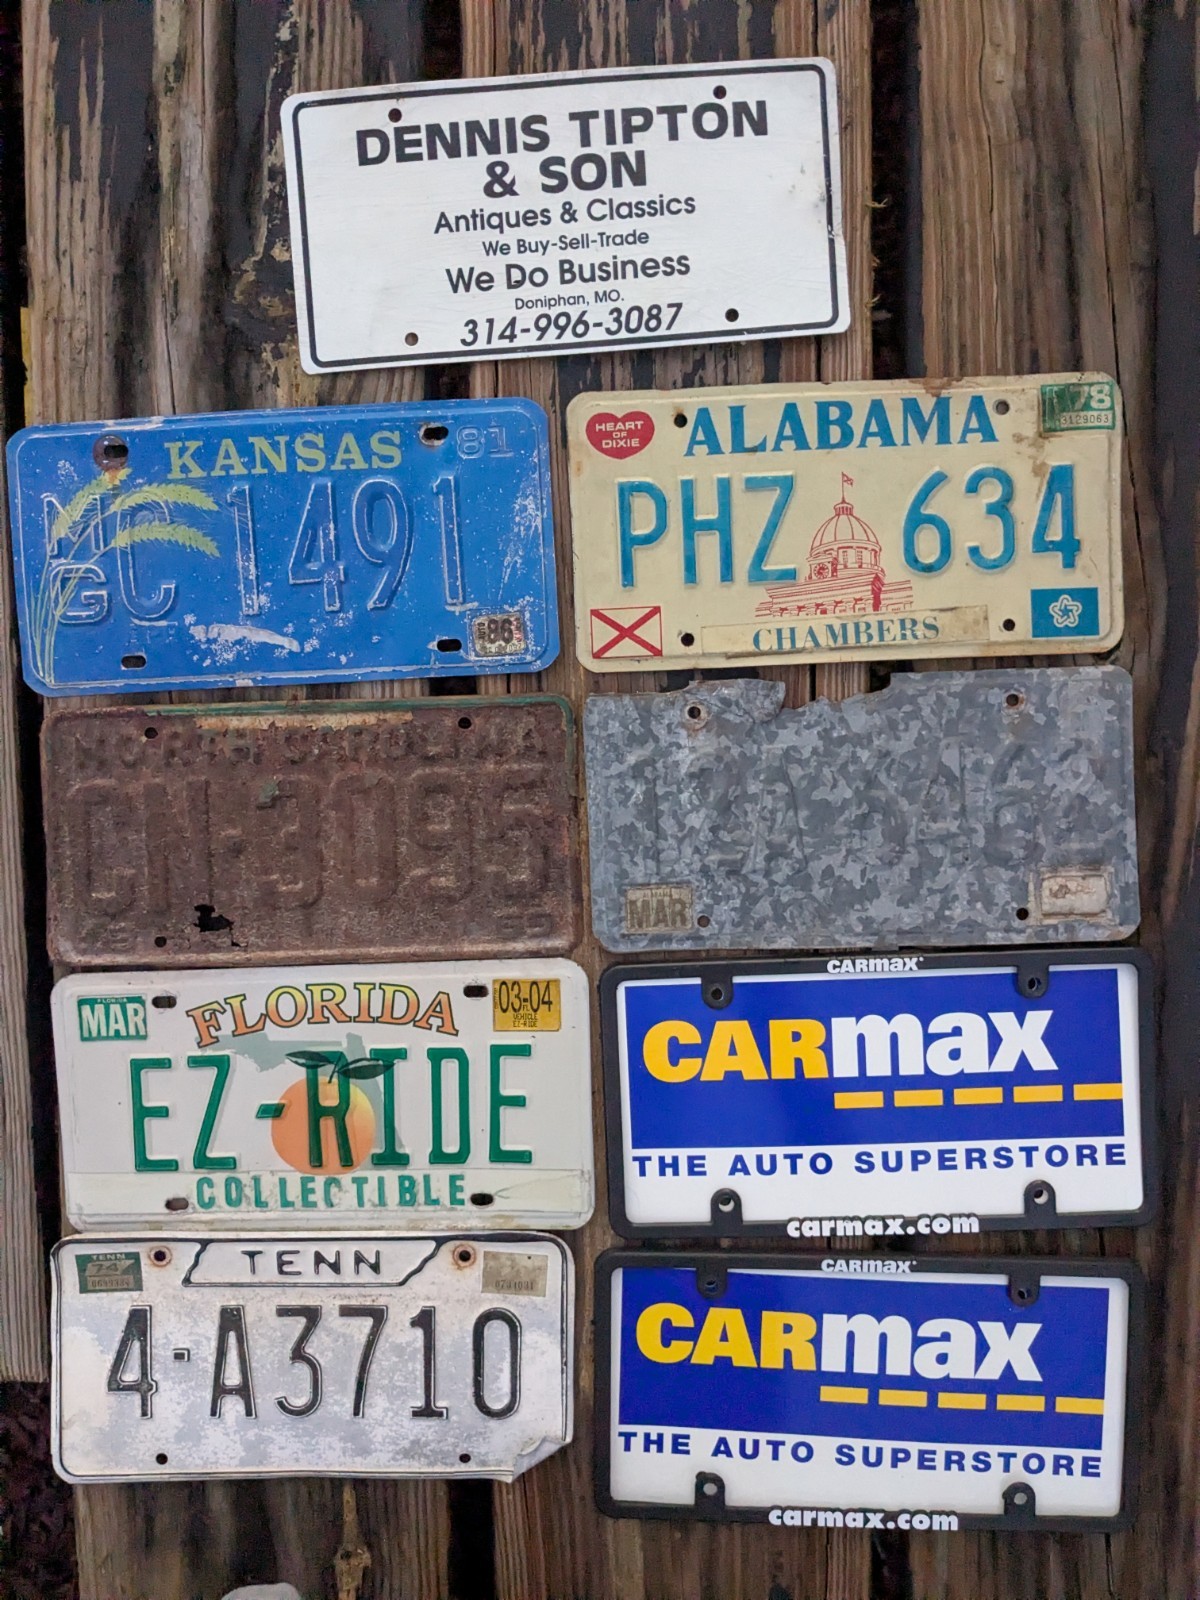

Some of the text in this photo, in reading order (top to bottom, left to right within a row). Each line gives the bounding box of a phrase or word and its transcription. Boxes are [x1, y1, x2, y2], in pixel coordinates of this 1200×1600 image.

[356, 99, 768, 167] DENNIS TIPTON
[483, 150, 647, 199] & SON
[434, 194, 696, 235] Antiques & Classics
[482, 230, 649, 257] We Buy-Sell-Trade
[446, 253, 691, 295] We Do Business
[515, 290, 625, 312] Doniphan, MO.
[460, 302, 683, 348] 314-996-3087
[1069, 384, 1112, 410] 78
[595, 421, 644, 432] HEART
[683, 395, 1000, 457] ALABAMA
[1061, 414, 1109, 426] 3129063
[165, 431, 402, 479] KANSAS
[457, 425, 514, 459] 81
[602, 438, 640, 449] DIXIE
[616, 463, 1081, 589] PHZ 634
[488, 618, 514, 644] 86
[752, 616, 940, 652] CHAMBERS
[629, 899, 686, 928] MAR
[185, 981, 460, 1049] FLORIDA
[498, 980, 553, 1014] 03-04
[80, 1003, 146, 1038] MAR
[512, 1020, 539, 1028] EZ-RIDE
[642, 1009, 1059, 1084] CARmax
[129, 1042, 532, 1174] EZ-RIDE
[632, 1142, 1127, 1178] THE AUTO SUPERSTORE
[196, 1173, 465, 1209] COLLECTIBLE
[786, 1214, 980, 1239] carmax.com
[91, 1253, 126, 1261] TENN
[240, 1249, 382, 1277] TENN
[635, 1302, 1043, 1382] CARmax
[106, 1303, 523, 1420] 4-A3710
[618, 1431, 1102, 1478] THE AUTO SUPERSTORE
[768, 1508, 959, 1532] carmax.com
